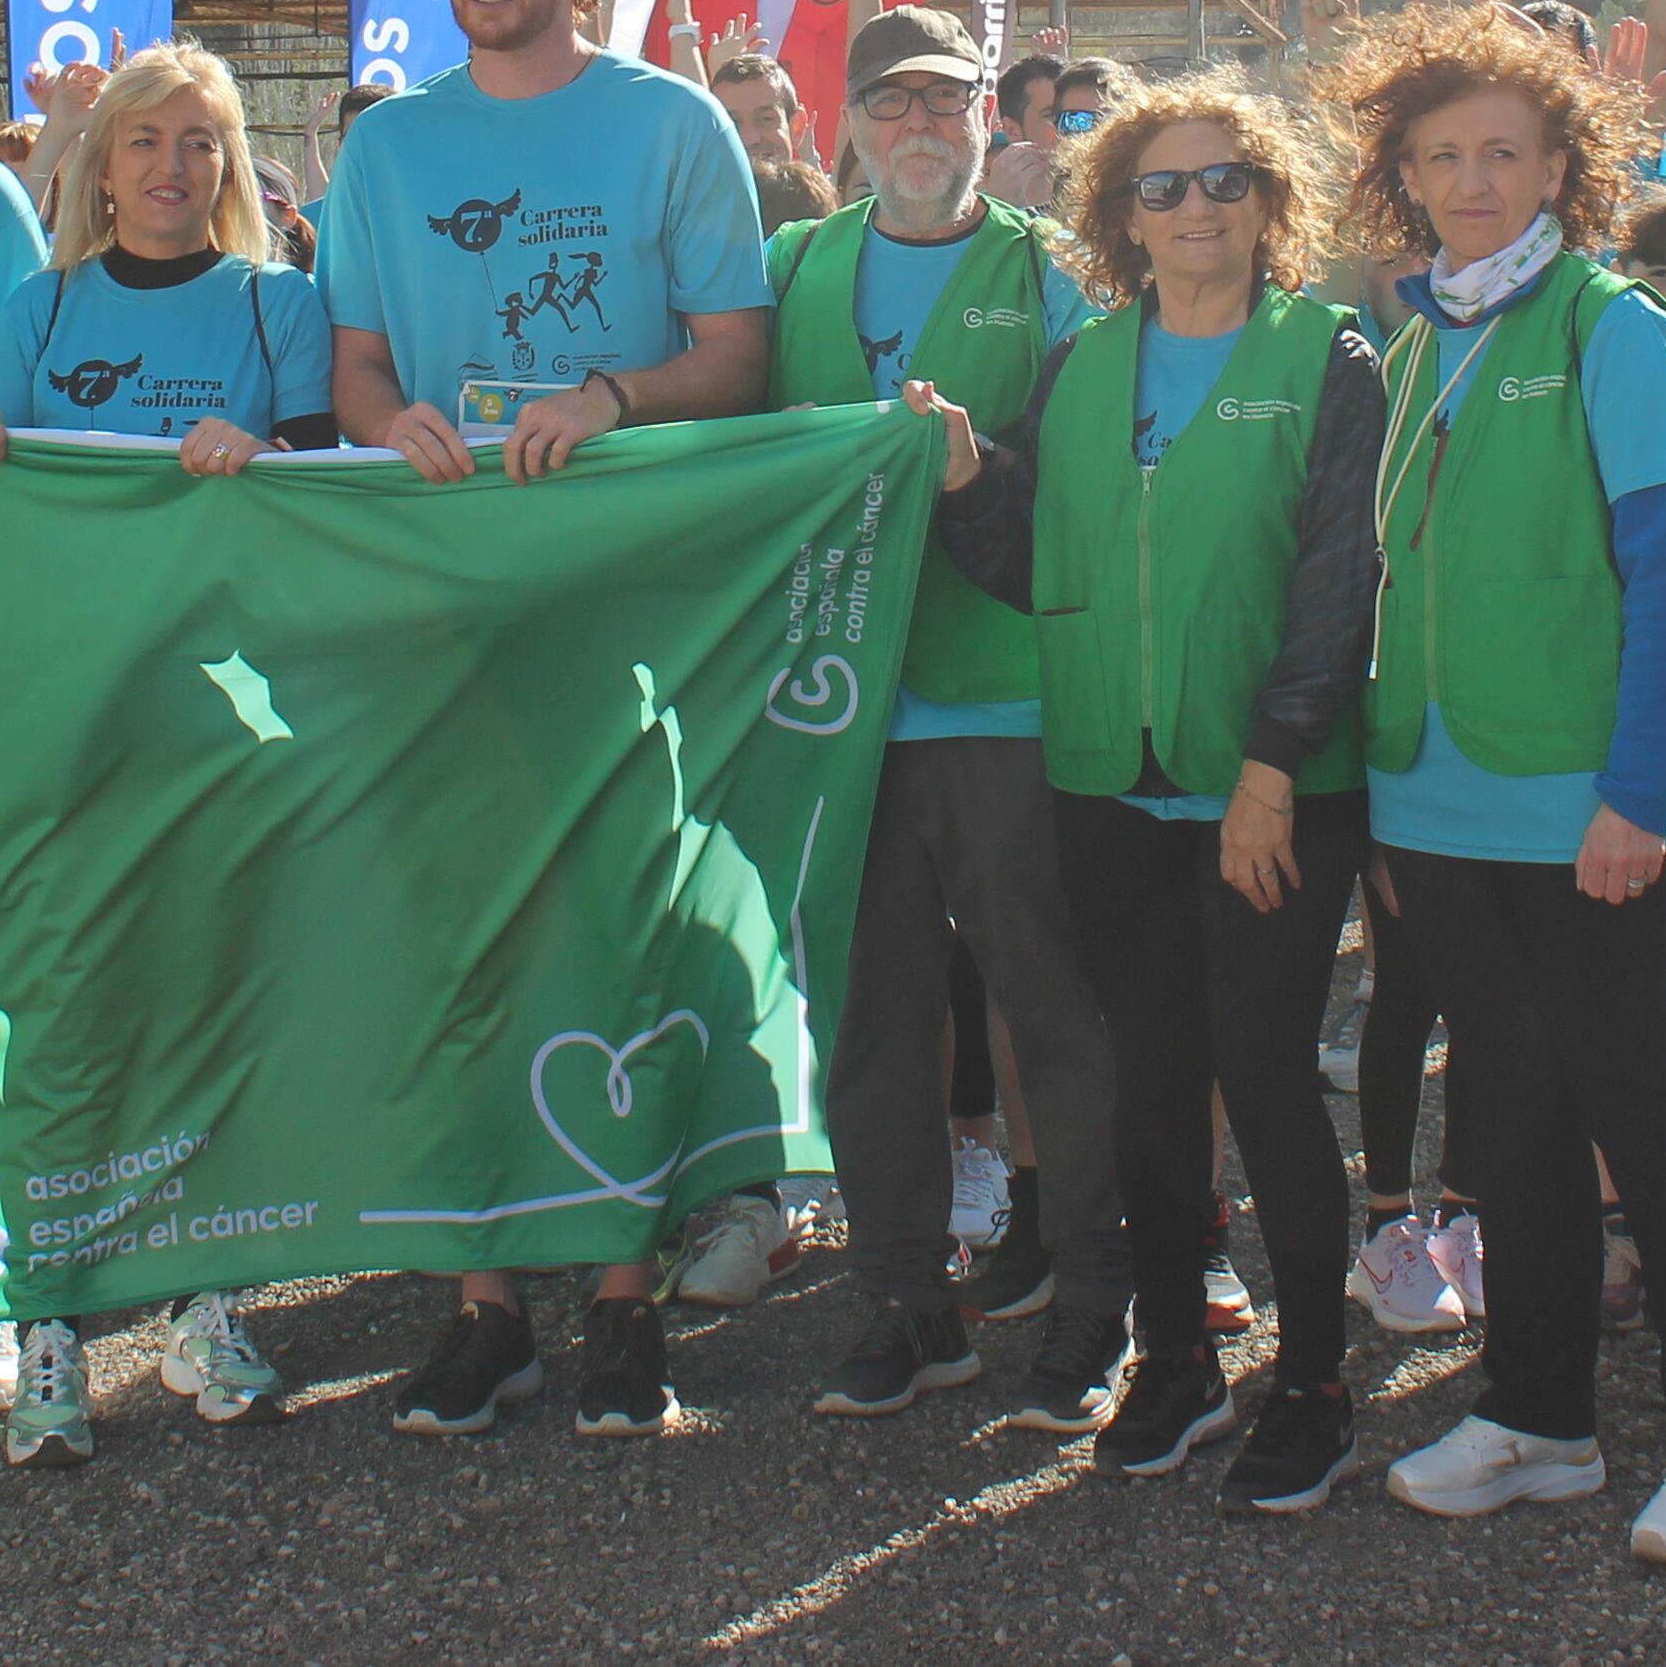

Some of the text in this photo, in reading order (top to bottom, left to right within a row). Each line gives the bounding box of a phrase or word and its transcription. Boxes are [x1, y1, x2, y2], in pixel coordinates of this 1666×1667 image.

[520, 204, 604, 227] Carrera
[517, 220, 609, 248] solidaria
[137, 375, 223, 391] Carrera
[130, 391, 226, 409] solidaria
[845, 472, 885, 643] contra el cáncer
[26, 1129, 211, 1202] asociación
[147, 1216, 179, 1248] el
[188, 1197, 319, 1243] cáncer
